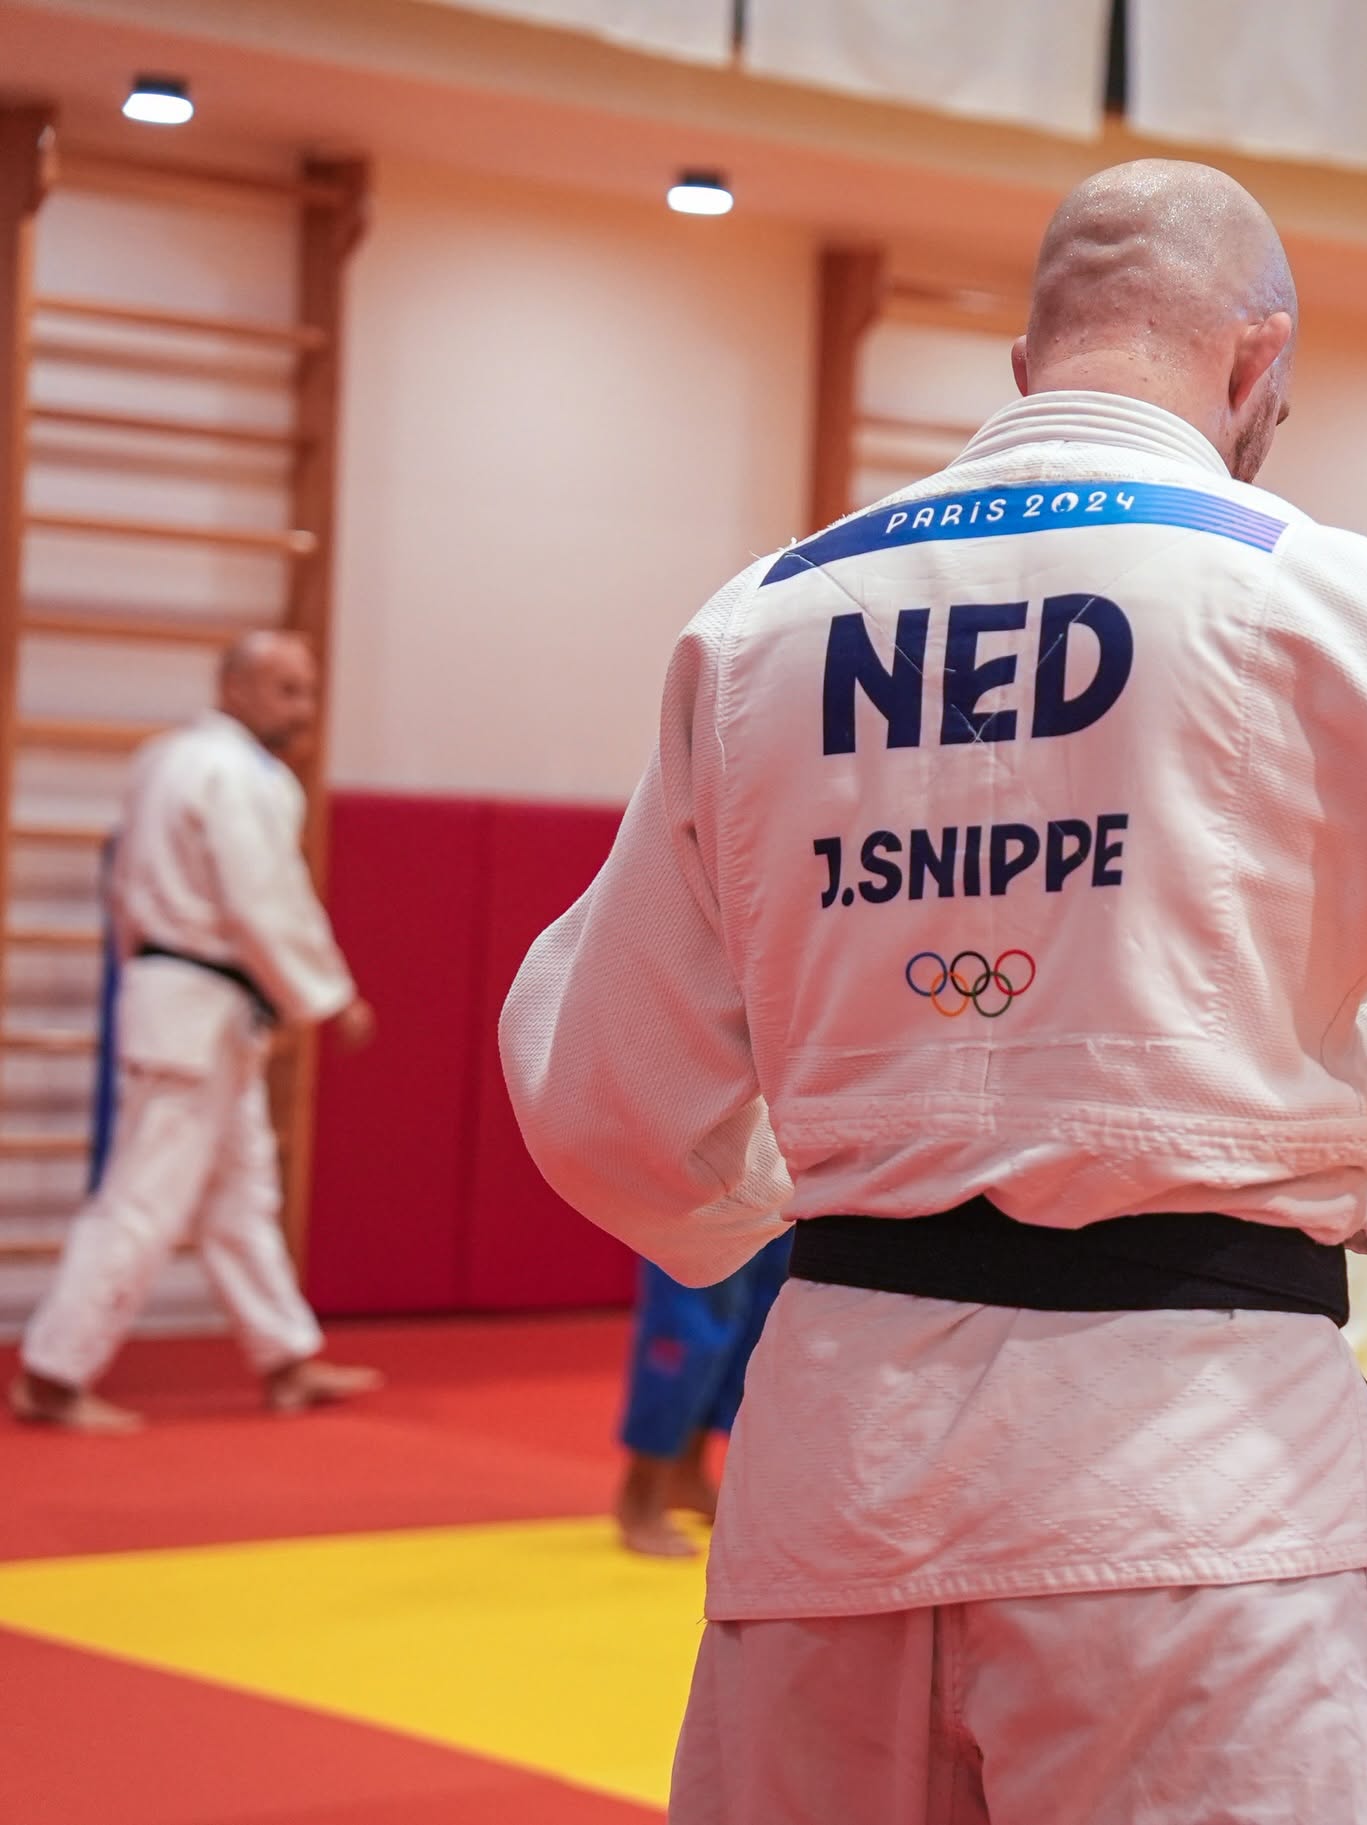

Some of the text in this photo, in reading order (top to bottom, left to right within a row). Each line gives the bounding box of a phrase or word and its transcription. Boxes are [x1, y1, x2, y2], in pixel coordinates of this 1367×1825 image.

[1022, 491, 1135, 518] 2024
[822, 593, 1134, 756] NED
[813, 813, 1129, 909] J.SNIPPE
